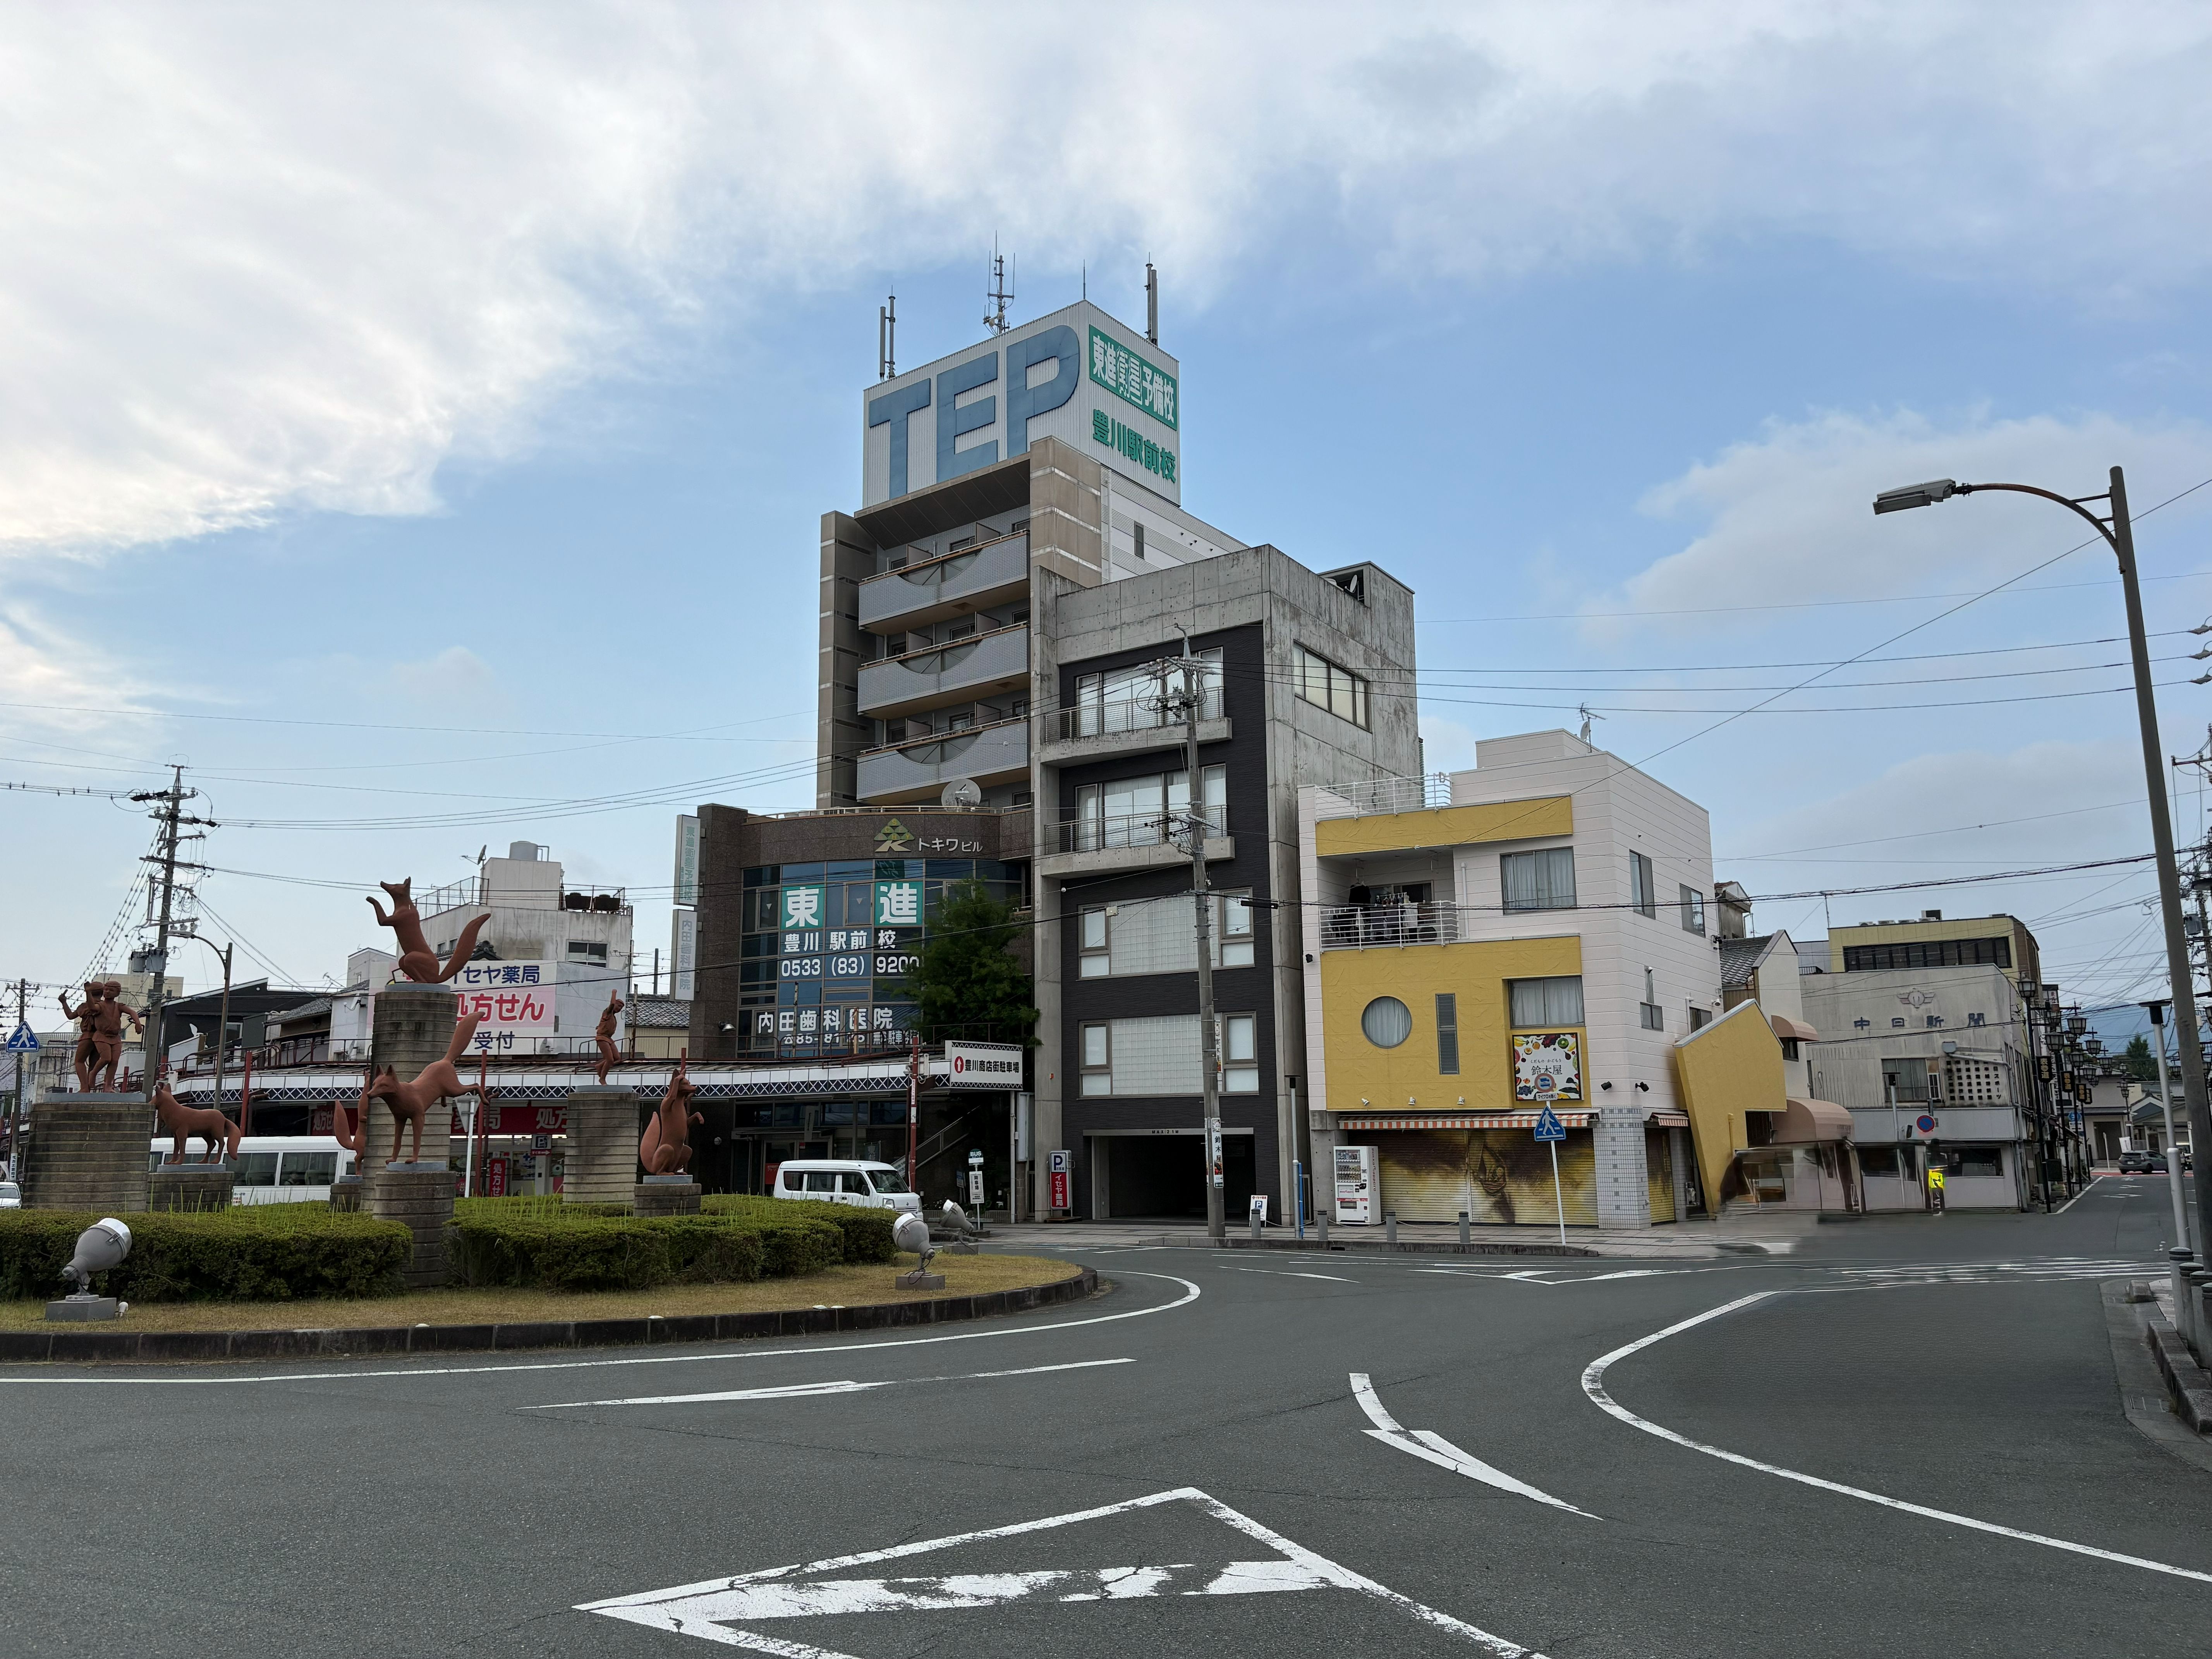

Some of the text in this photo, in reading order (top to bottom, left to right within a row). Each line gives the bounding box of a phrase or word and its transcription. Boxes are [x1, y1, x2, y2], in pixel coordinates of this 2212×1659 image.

[1093, 335, 1175, 423] 東進衛星予備校
[869, 325, 1079, 500] TEP
[1093, 409, 1176, 484] 豊川駅前校
[919, 838, 983, 852] トキワビル
[785, 883, 917, 927] 東進
[784, 930, 896, 953] 豊川駅前校
[781, 959, 821, 977] 0533
[831, 957, 865, 976] (83)
[758, 1008, 893, 1034] 内田歯科医院
[1854, 1013, 1985, 1031] 中日新聞
[474, 1030, 515, 1050] 受付
[965, 1060, 1019, 1073] 豊川商店街駐車場
[1531, 1065, 1563, 1075] 鈴木屋
[1054, 1155, 1063, 1171] P
